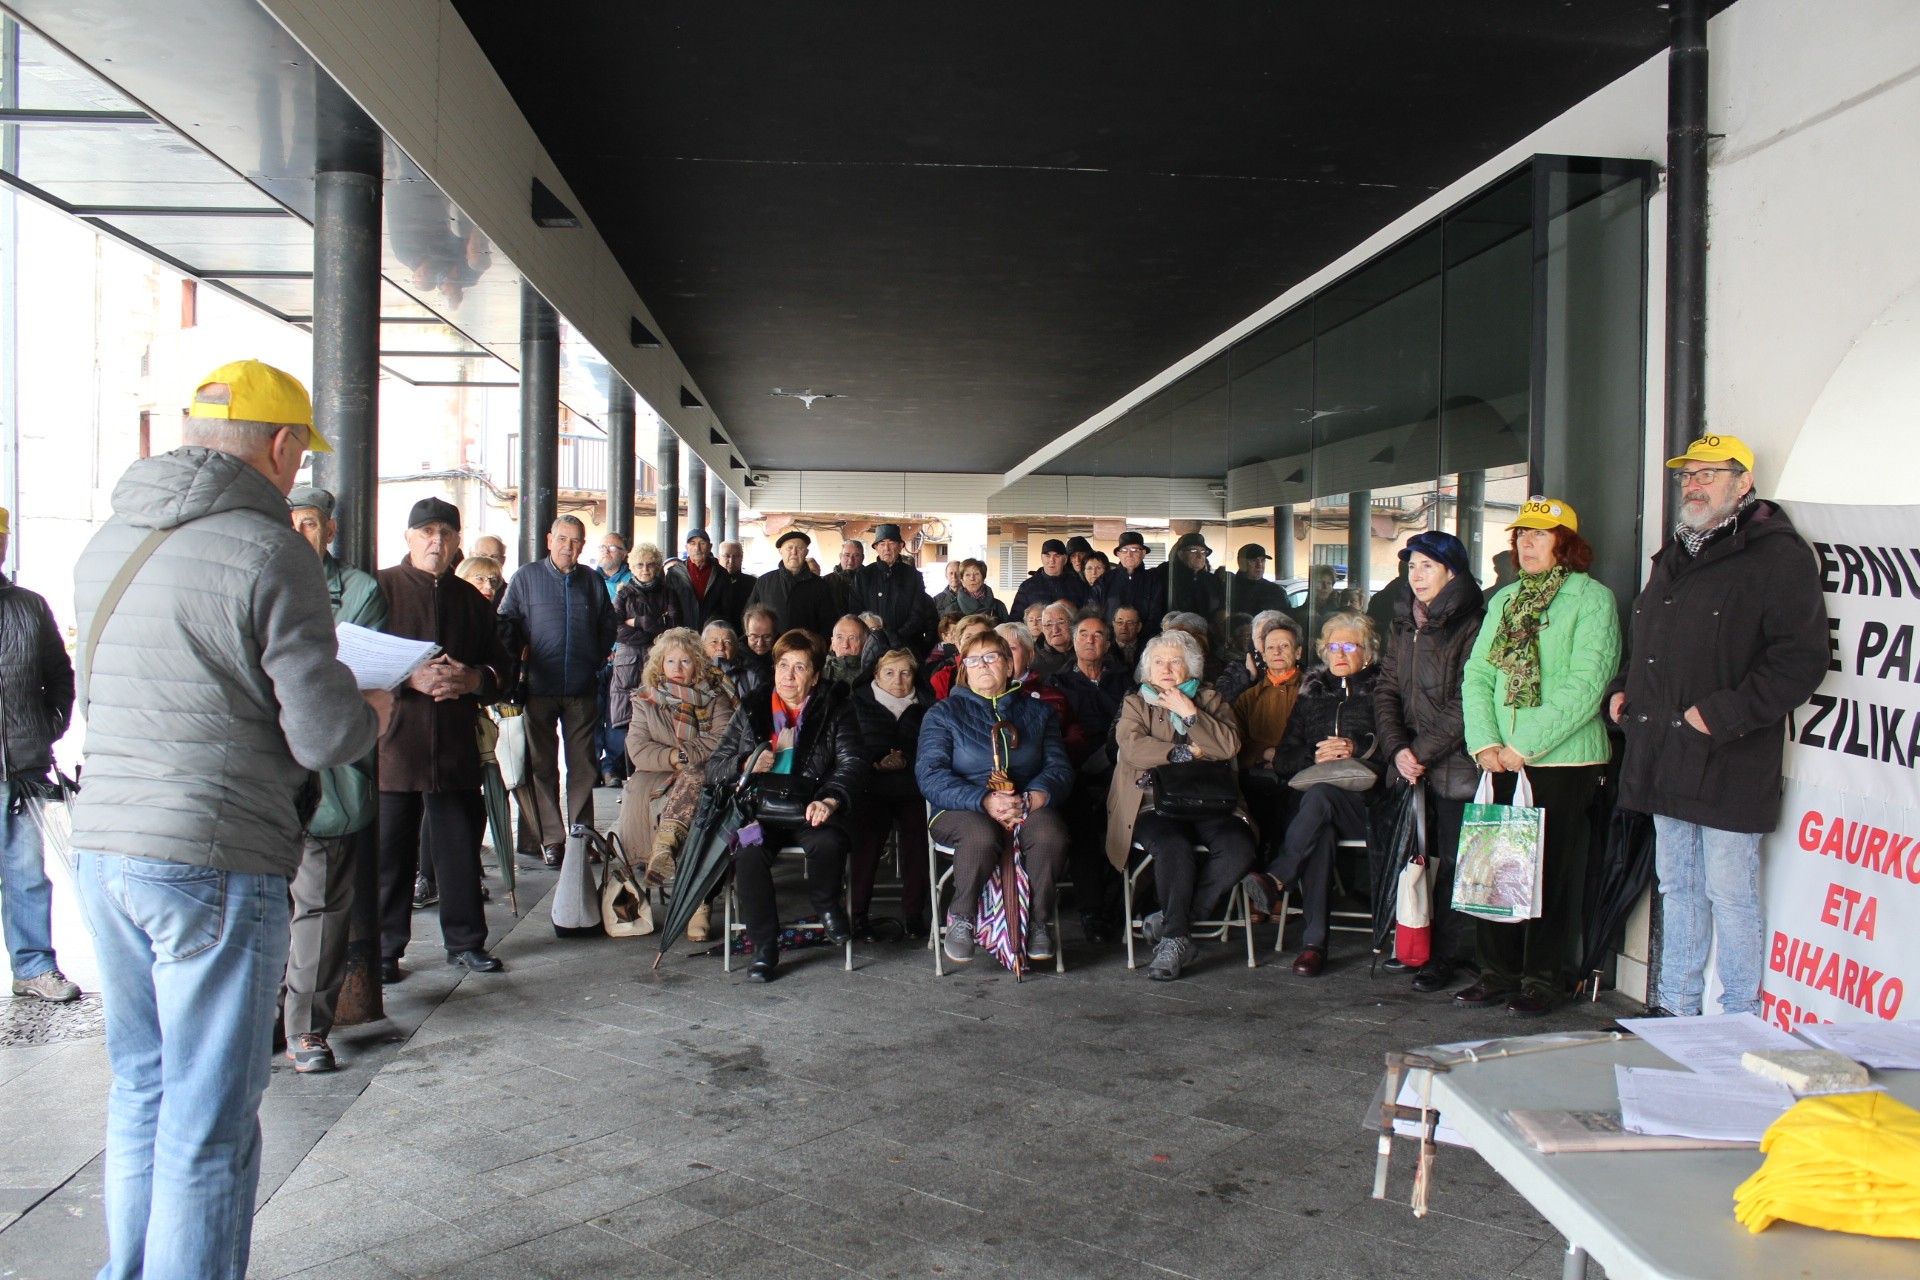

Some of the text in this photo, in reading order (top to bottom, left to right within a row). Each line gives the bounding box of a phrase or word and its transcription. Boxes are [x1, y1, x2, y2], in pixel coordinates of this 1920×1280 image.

[1856, 621, 1920, 684] PA
[1799, 810, 1920, 884] GAURKO
[1820, 882, 1878, 942] ETA
[1769, 930, 1904, 1021] BIHARKO
